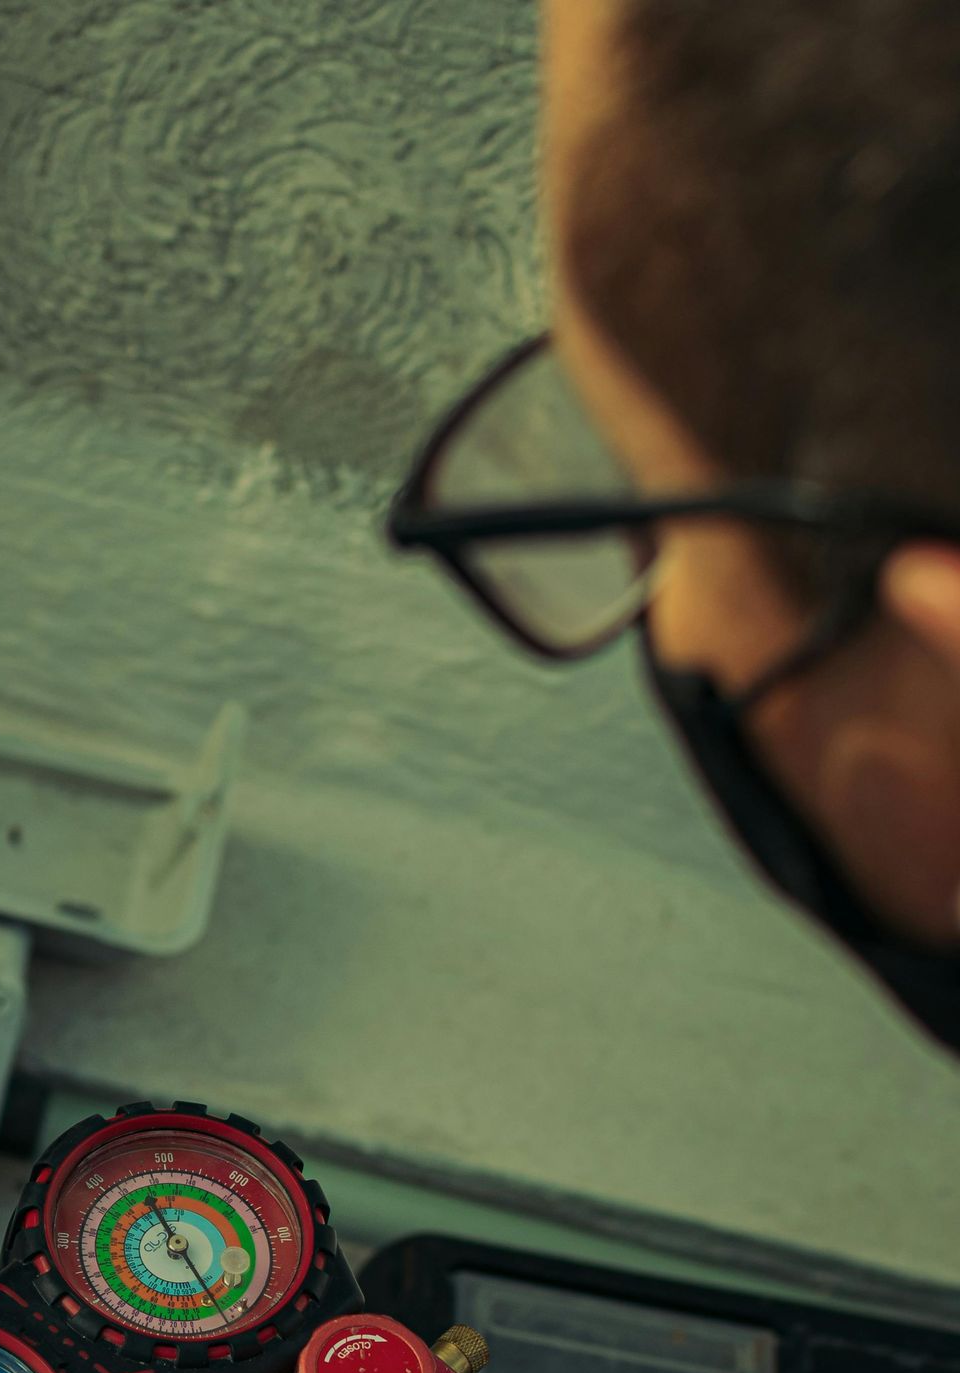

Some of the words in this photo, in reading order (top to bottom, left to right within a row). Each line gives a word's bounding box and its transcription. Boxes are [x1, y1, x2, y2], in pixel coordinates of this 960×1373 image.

[58, 1232, 69, 1249] 300
[86, 1174, 103, 1189] 400
[154, 1153, 174, 1163] 500
[229, 1171, 248, 1187] 600
[277, 1226, 292, 1242] 700
[338, 1341, 371, 1359] CLOSED
